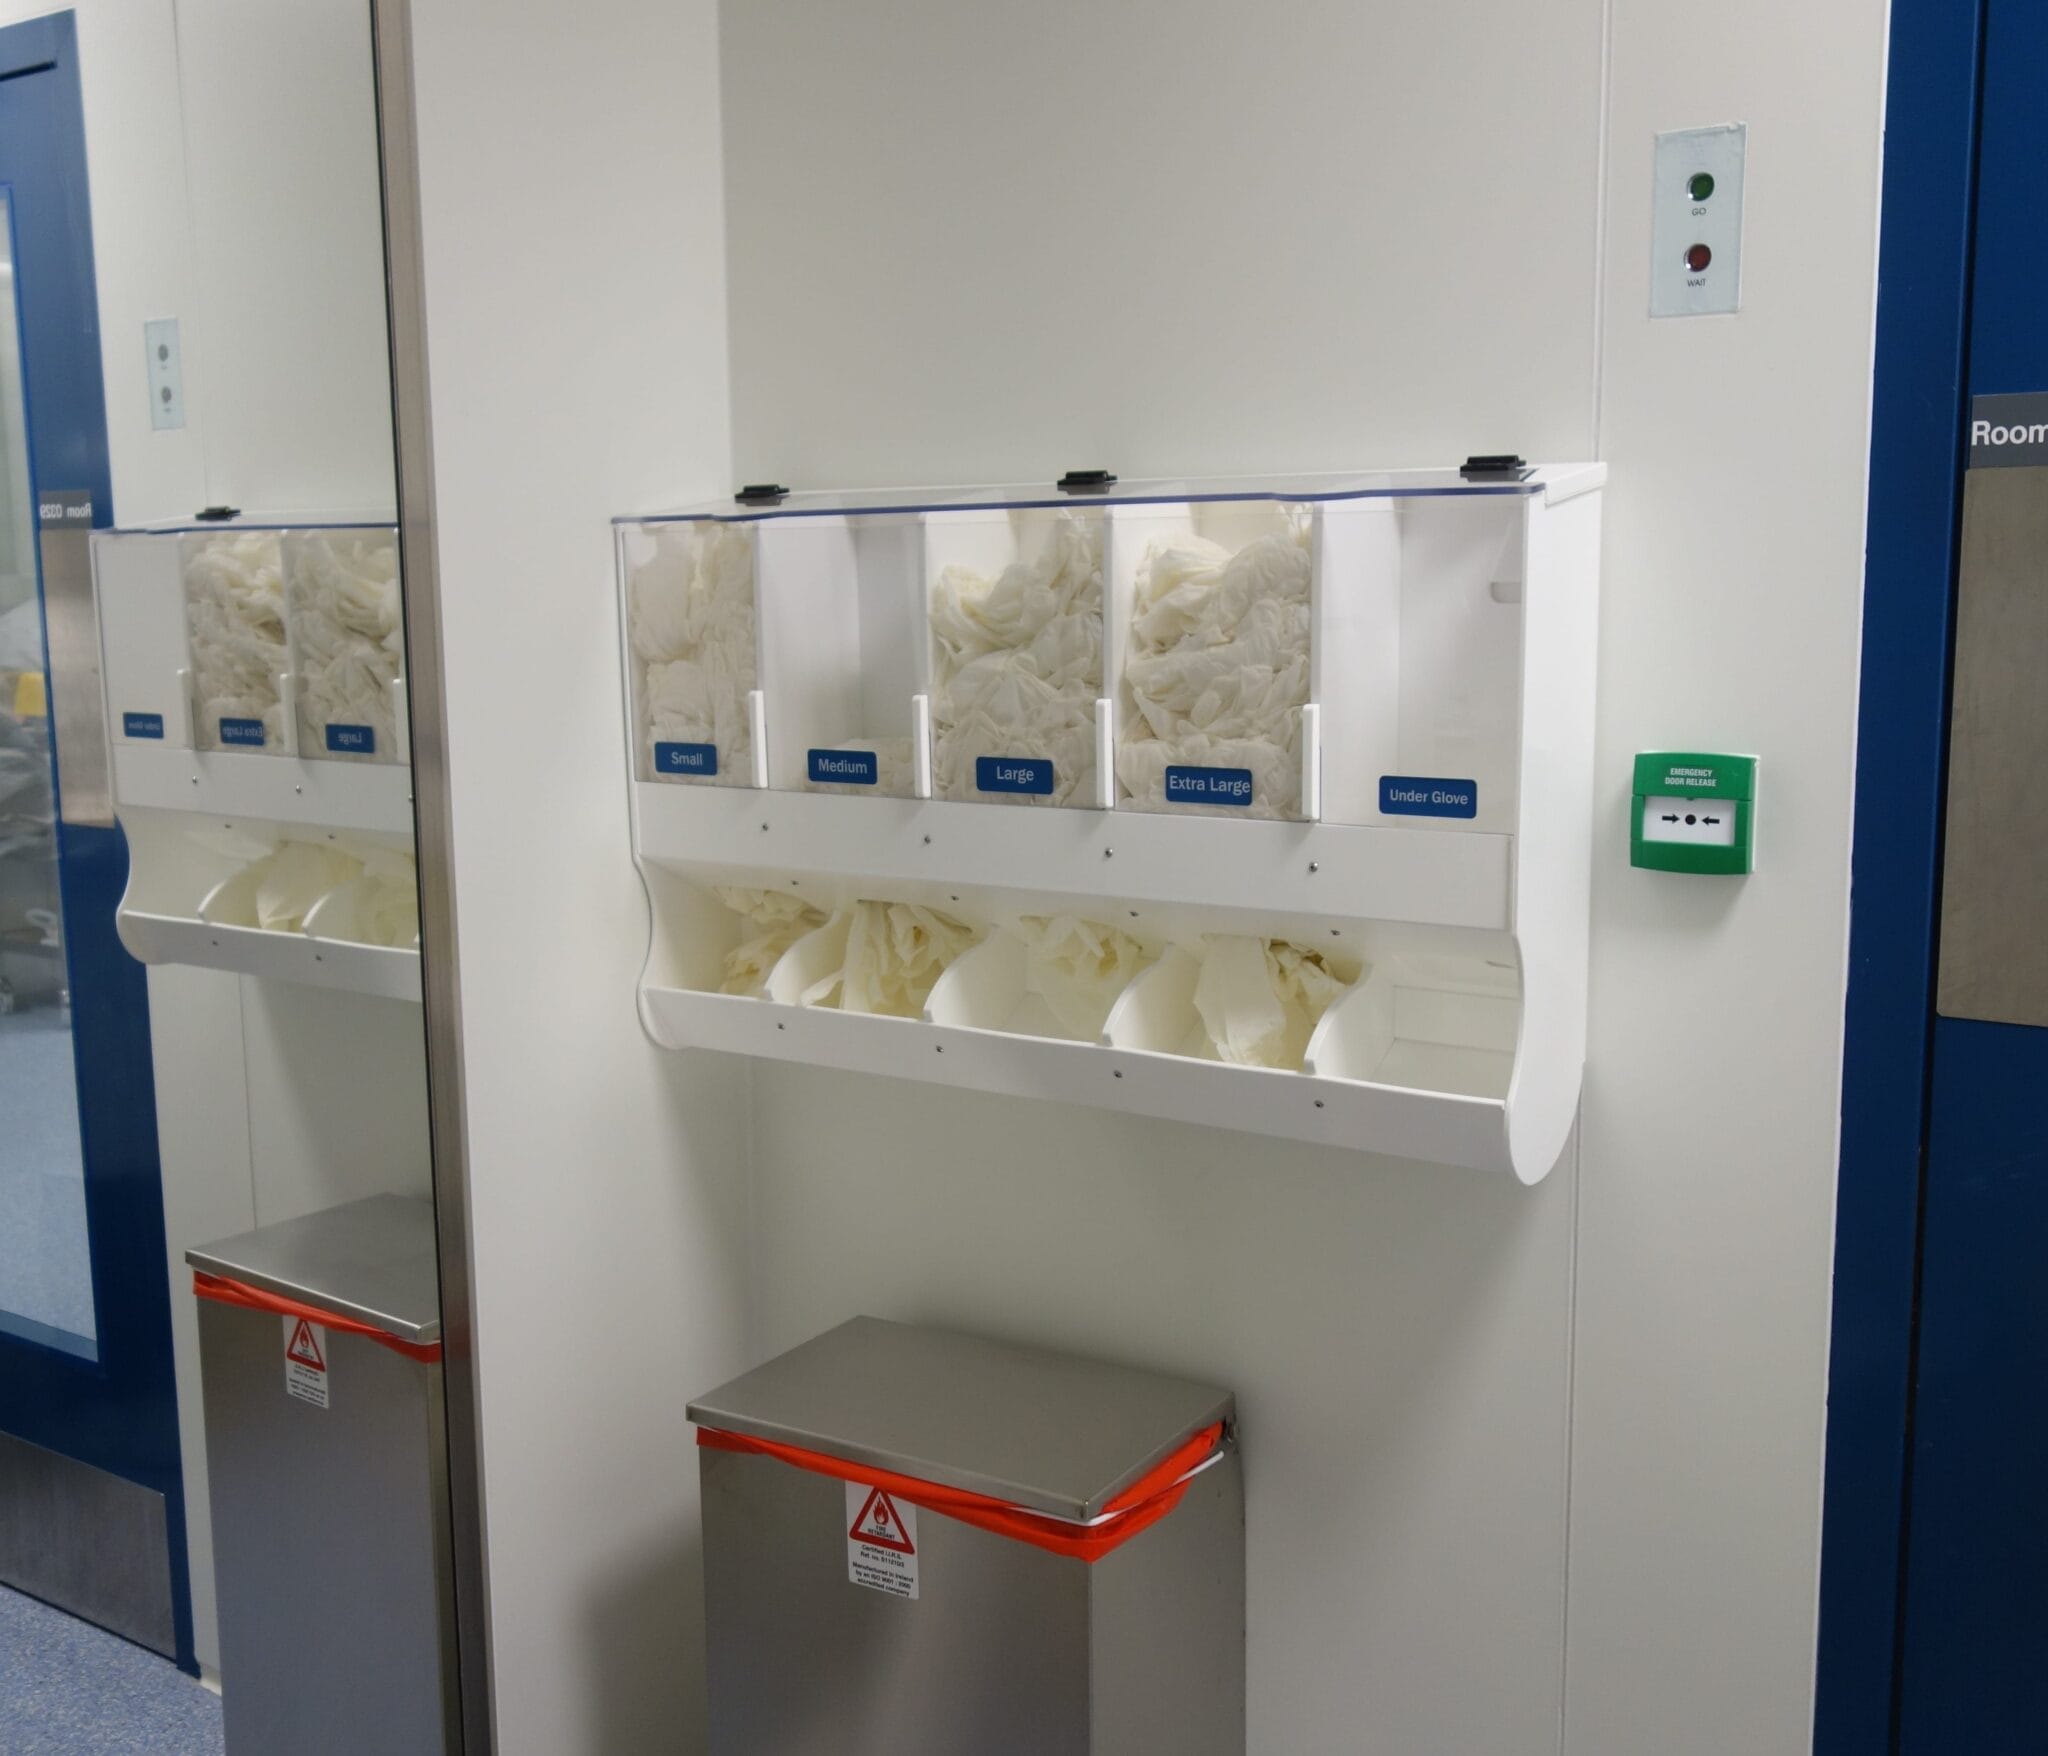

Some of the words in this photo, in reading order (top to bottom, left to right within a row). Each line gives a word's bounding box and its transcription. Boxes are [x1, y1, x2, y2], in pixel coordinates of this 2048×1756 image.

[1692, 208, 1706, 216] GO
[1687, 278, 1707, 287] WAIT
[1971, 420, 2048, 446] Room
[670, 751, 703, 767] Small
[817, 758, 868, 775] Medium
[996, 766, 1034, 783] Large
[1670, 768, 1713, 777] EMERGENCY
[1169, 774, 1206, 792] Extra
[1210, 776, 1251, 795] Large
[1665, 777, 1685, 786] DOOR
[1686, 778, 1717, 787] RELEASE
[1389, 788, 1428, 803] Under
[1431, 791, 1469, 806] Glove
[853, 1561, 888, 1576] Manufactured
